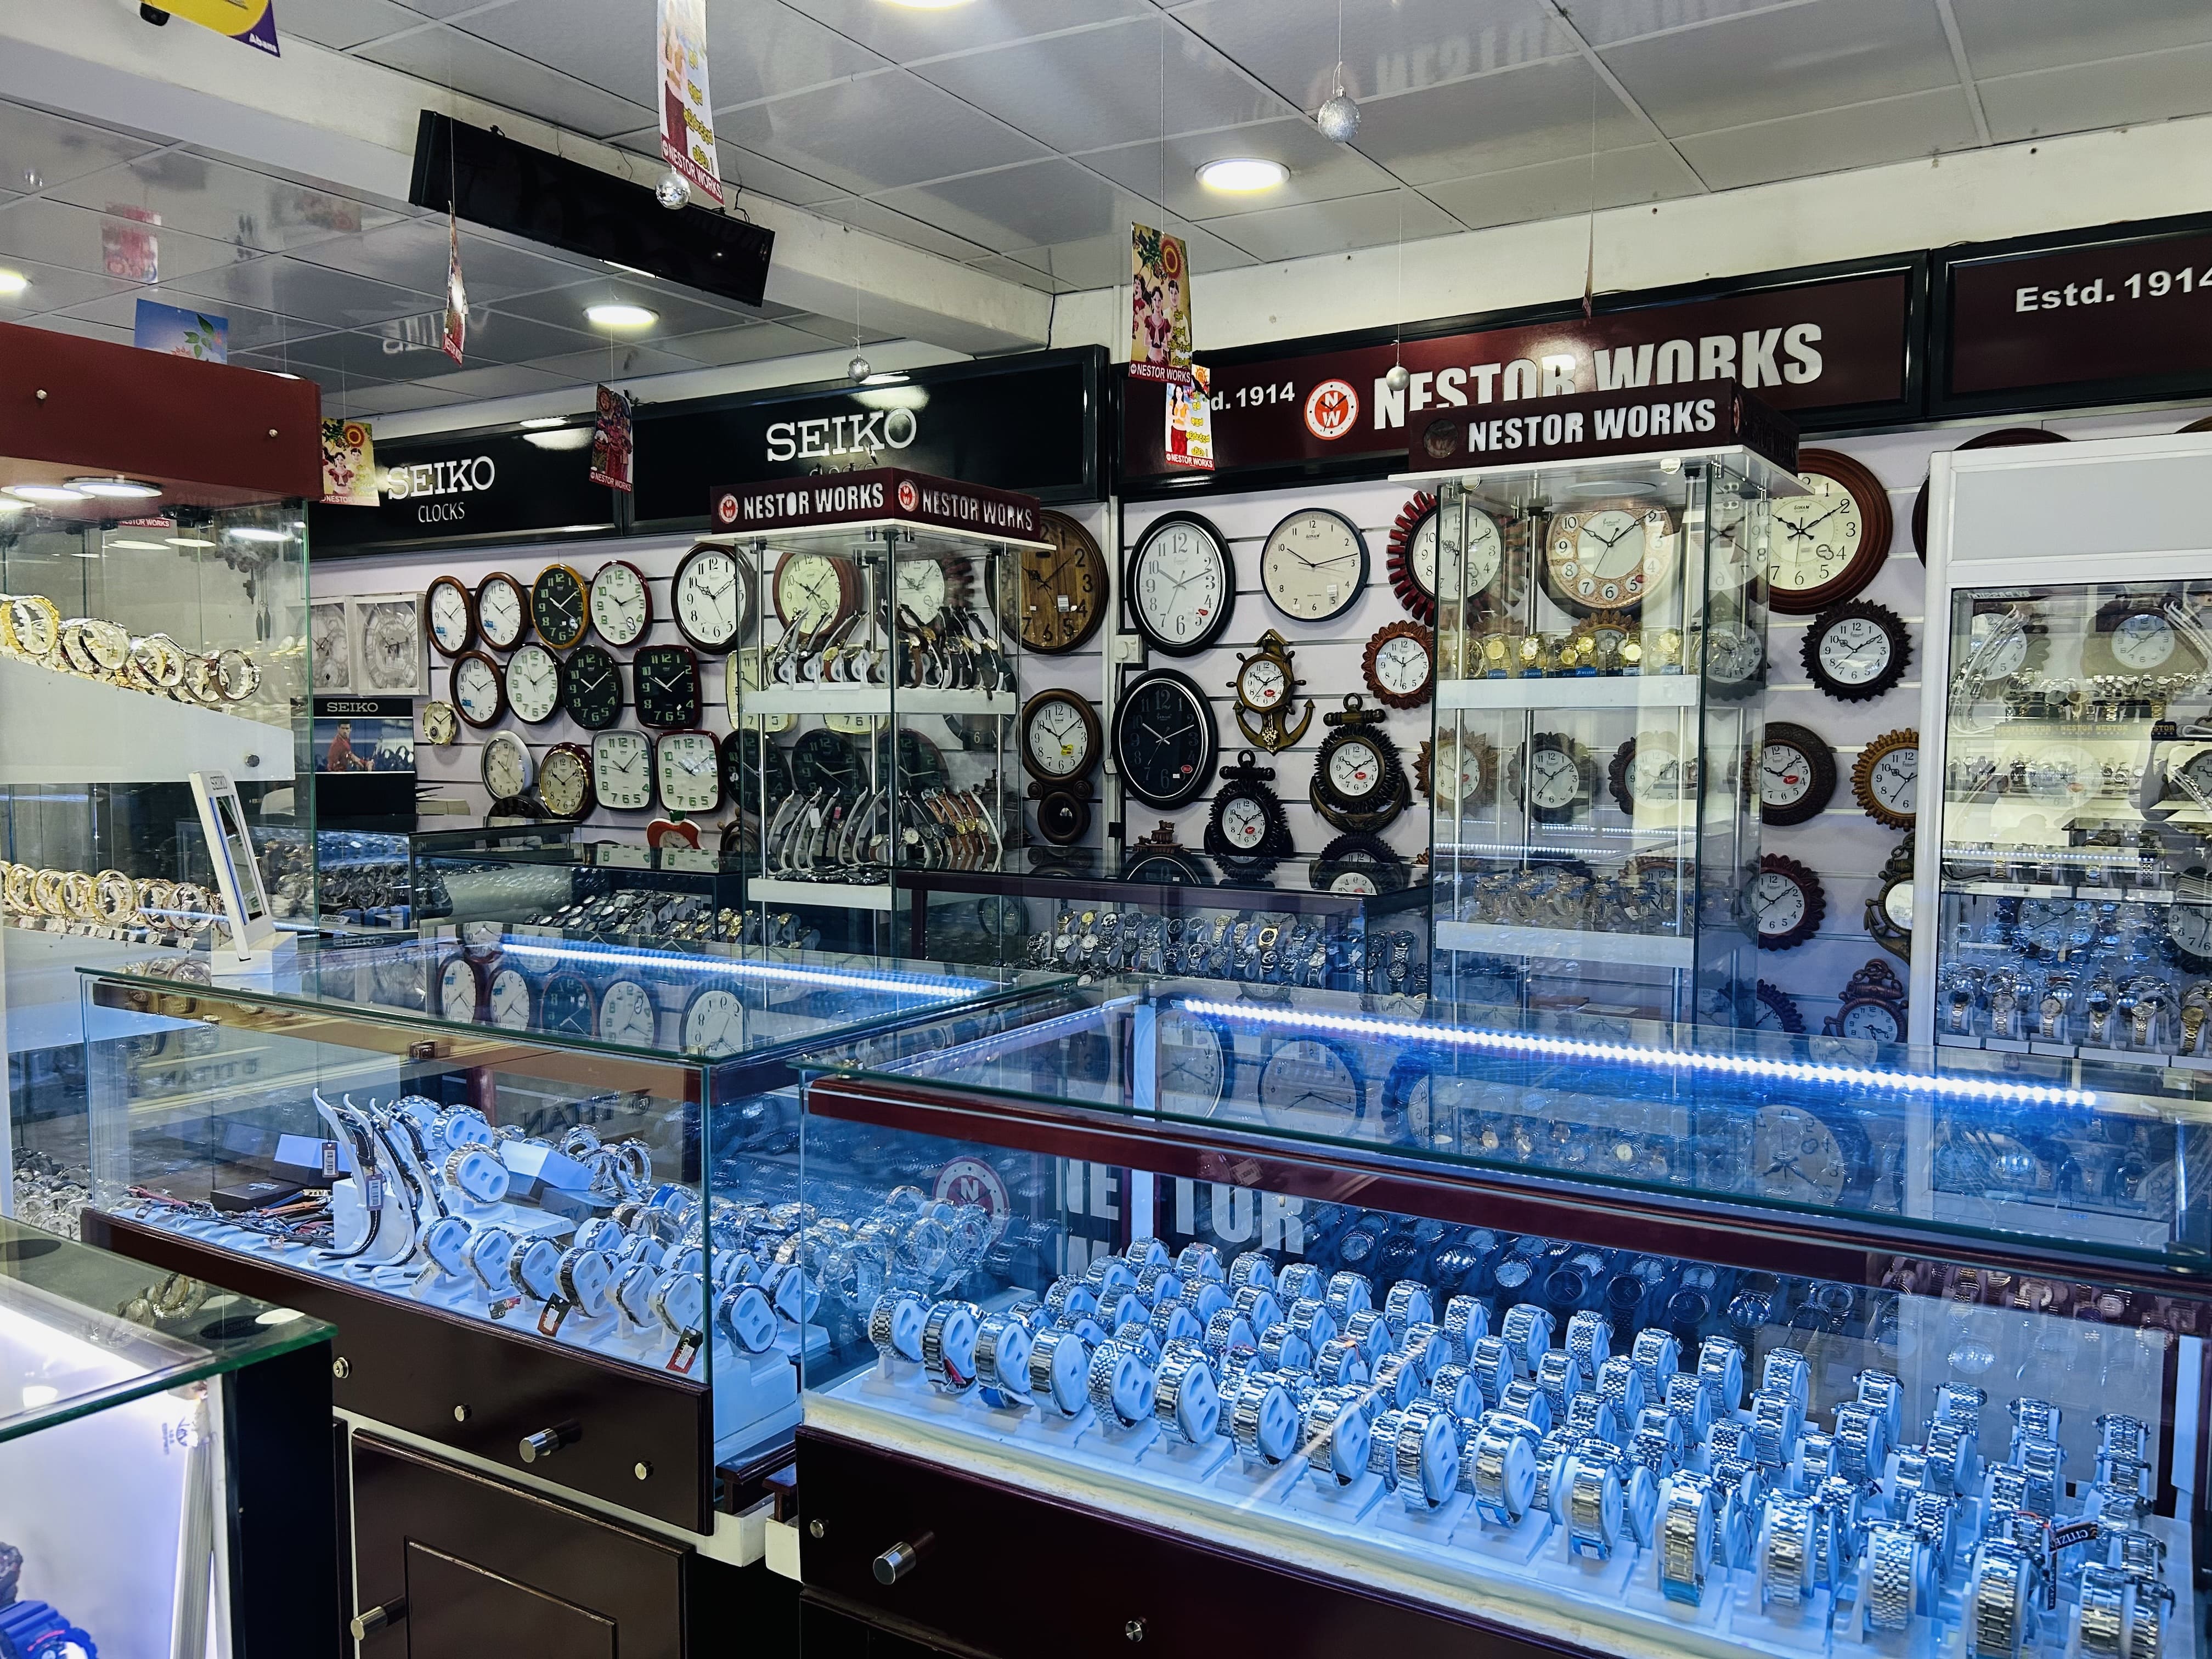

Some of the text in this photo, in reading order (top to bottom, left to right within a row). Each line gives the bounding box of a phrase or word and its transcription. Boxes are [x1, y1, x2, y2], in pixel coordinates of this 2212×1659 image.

[668, 143, 723, 199] NESTOR WORKS
[2016, 279, 2115, 312] Estd.
[1137, 363, 1190, 383] NESTOR WORKS
[1374, 323, 1822, 430] NESTOR WORKS
[1236, 382, 1295, 408] 1914
[1468, 399, 1716, 452] NESTOR WORKS
[766, 407, 917, 461] SEIKO
[1171, 454, 1213, 468] NESTOR WORKS
[387, 455, 495, 500] SEIKO
[595, 472, 631, 492] NESTOR WORKS
[326, 495, 353, 504] NESTOR
[744, 483, 884, 520] NESTOR WORKS
[1838, 499, 1849, 514] 2
[418, 501, 465, 523] CLOCKS
[922, 488, 1034, 531] NESTOR WORKS
[146, 518, 170, 527] WORKS
[1564, 515, 1576, 529] 10
[1846, 522, 1855, 537] 3
[1058, 527, 1067, 551] 1
[1173, 533, 1187, 553] 12
[1559, 541, 1567, 551] 9
[1159, 543, 1165, 556] 11
[1197, 540, 1199, 554] 1
[1836, 546, 1846, 560] 4
[709, 557, 718, 570] 12
[1075, 548, 1085, 567] 2
[1204, 557, 1211, 568] 2
[698, 563, 703, 574] 11
[1149, 561, 1160, 574] 10
[1565, 565, 1573, 577] 8
[1771, 566, 1780, 580] 7
[1820, 565, 1829, 578] 5
[555, 574, 565, 582] 12
[1083, 573, 1094, 592] 3
[1206, 575, 1215, 589] 3
[1795, 571, 1804, 585] 6
[499, 583, 504, 591] 12
[1146, 579, 1155, 592] 9
[1582, 582, 1589, 593] 7
[1606, 586, 1614, 598] 6
[687, 594, 693, 604] 9
[1150, 598, 1157, 611] 8
[1204, 595, 1211, 608] 4
[1075, 597, 1087, 618] 4
[543, 617, 549, 625] 8
[691, 611, 697, 622] 8
[1160, 614, 1166, 627] 7
[714, 627, 720, 637] 6
[726, 621, 733, 633] 5
[1022, 616, 1033, 635] 7
[1042, 623, 1053, 642] 6
[1177, 616, 1185, 635] 6
[559, 632, 566, 640] 6
[1880, 647, 1886, 655] 3
[685, 665, 692, 674] 2
[326, 702, 379, 713] SEIKO
[686, 699, 694, 708] 4
[654, 711, 661, 720] 7
[2055, 1529, 2088, 1547] CITIZE
